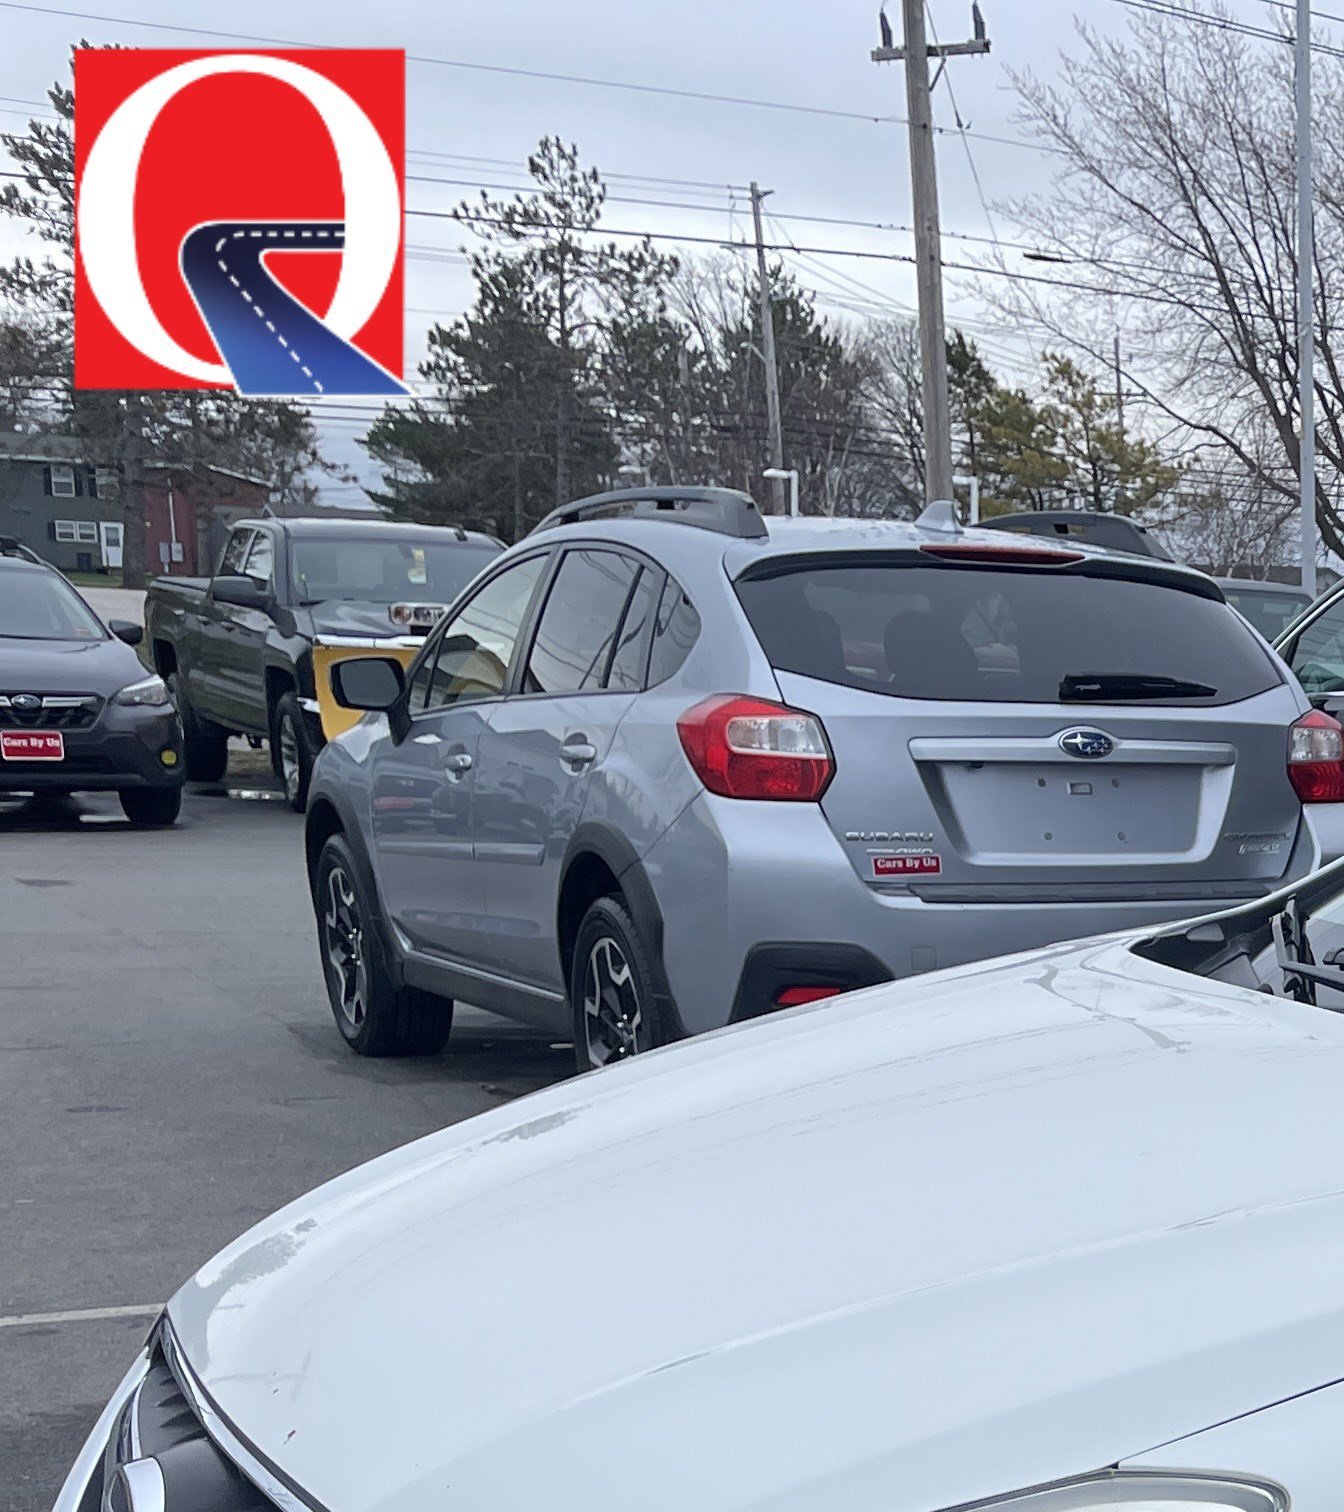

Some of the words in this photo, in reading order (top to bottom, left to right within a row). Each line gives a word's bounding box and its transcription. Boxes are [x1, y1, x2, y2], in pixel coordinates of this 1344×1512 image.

[877, 859, 903, 868] Cars
[906, 859, 920, 868] By
[923, 857, 936, 866] Us
